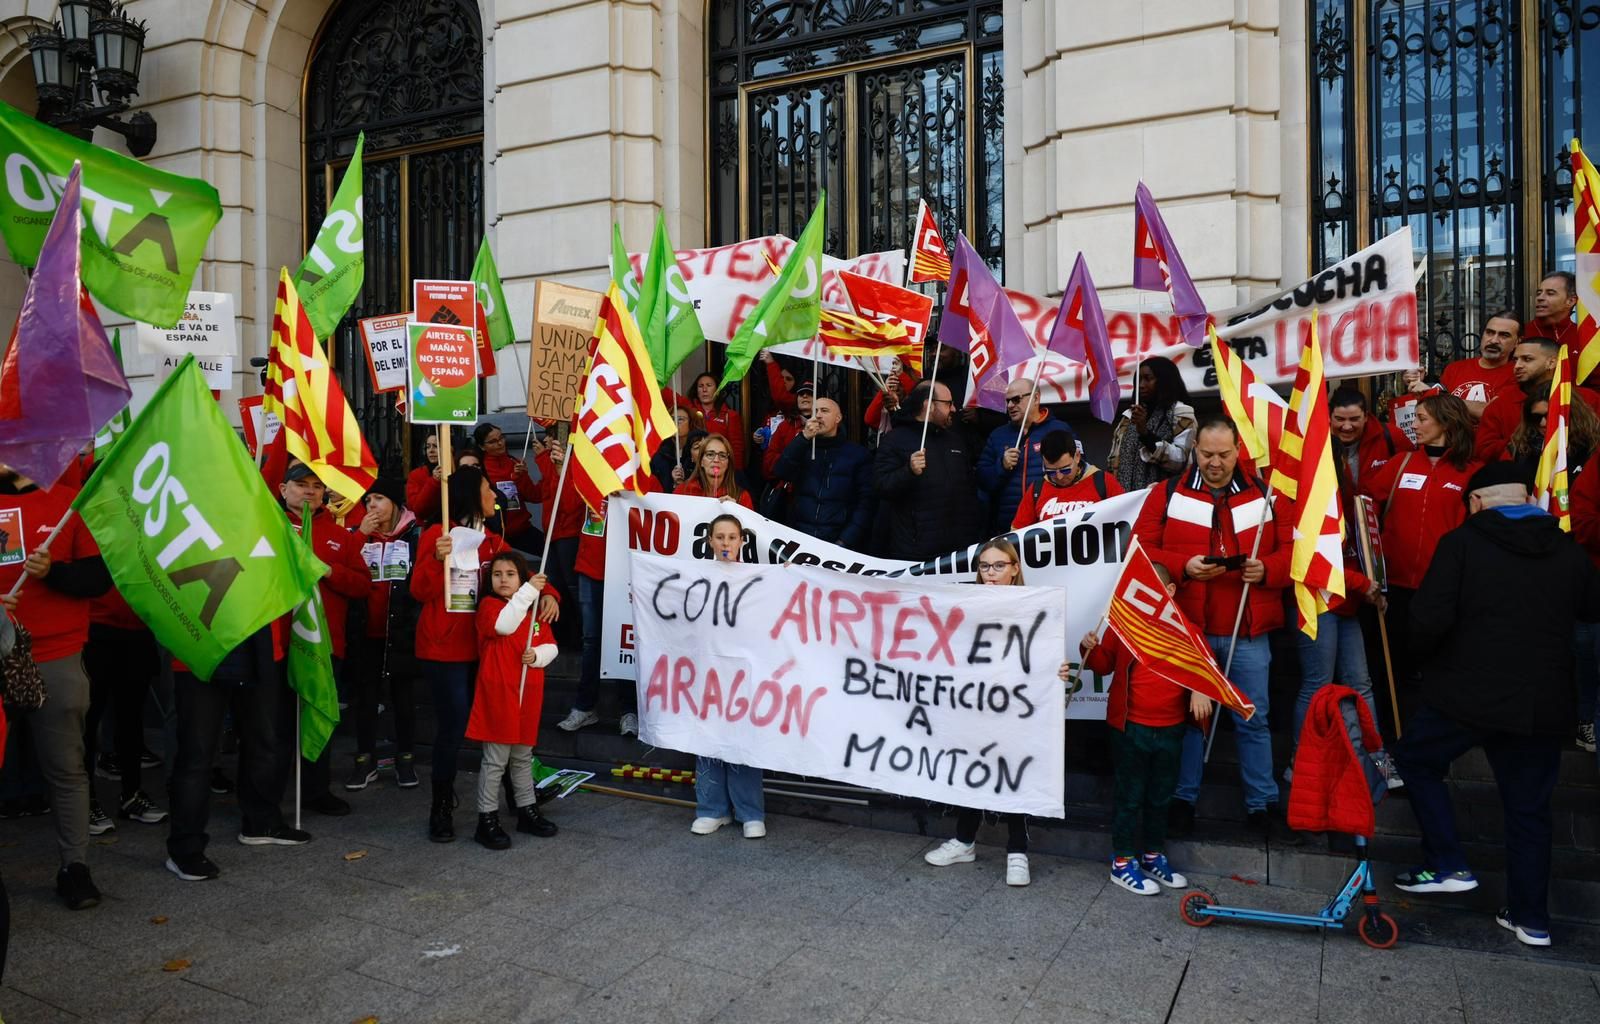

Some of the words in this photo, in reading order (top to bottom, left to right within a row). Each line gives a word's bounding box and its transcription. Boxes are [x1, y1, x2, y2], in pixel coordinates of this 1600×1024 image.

[166, 333, 208, 342] ESPAÑA
[371, 342, 388, 353] POR
[392, 339, 403, 349] EL
[426, 332, 455, 341] AIRTEX
[456, 333, 465, 341] ES
[1275, 291, 1420, 377] LUCHA
[420, 355, 433, 363] NO
[446, 356, 458, 364] VA
[459, 357, 471, 365] DE
[430, 343, 456, 353] MAÑA
[457, 345, 463, 353] Y
[537, 347, 587, 373] JAMA
[198, 361, 223, 371] ALLE
[375, 360, 390, 372] DEL
[431, 367, 465, 377] ESPAÑA
[538, 370, 578, 396] SER
[628, 507, 680, 556] NO
[652, 571, 764, 628] CON
[770, 580, 965, 666] AIRTEX
[967, 611, 1047, 674] EN
[645, 653, 828, 738] ARAGÓN
[843, 657, 1035, 719] BENEFICIOS
[906, 704, 933, 736] A
[843, 733, 1034, 795] MONTÓN
